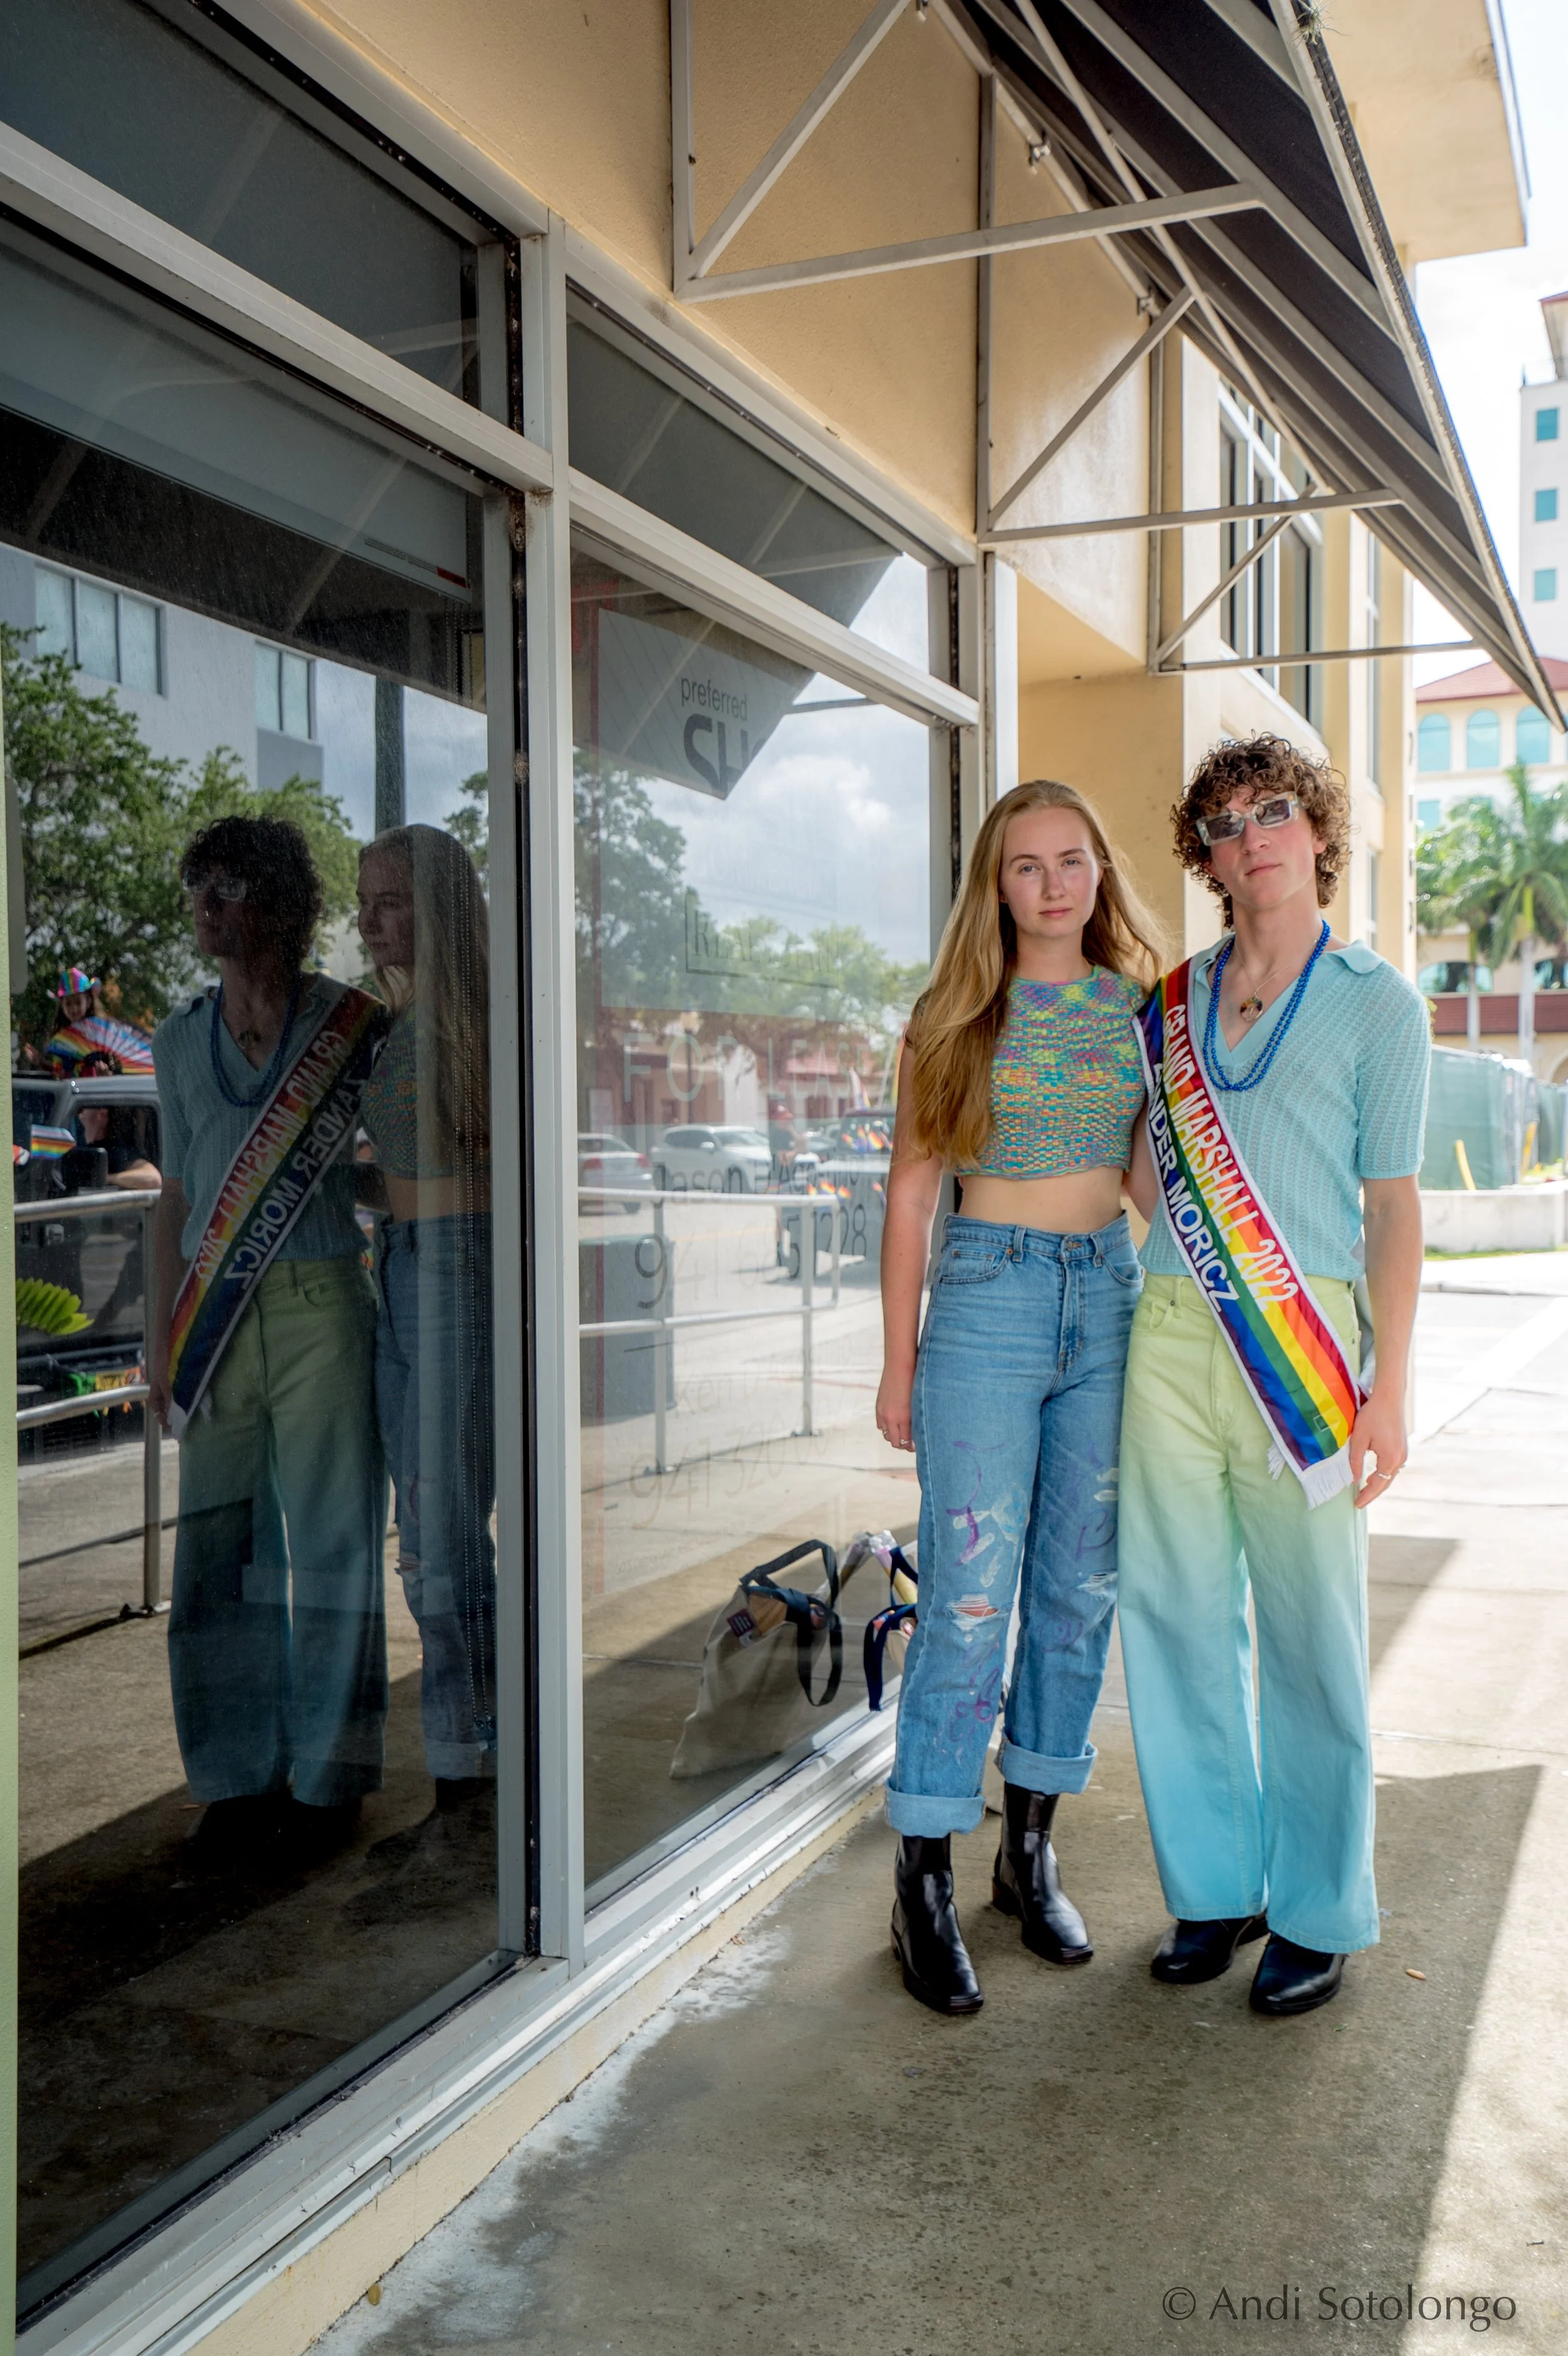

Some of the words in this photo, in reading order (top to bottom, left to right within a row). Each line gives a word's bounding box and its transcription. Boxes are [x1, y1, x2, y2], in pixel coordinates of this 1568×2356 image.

[681, 677, 748, 721] preferred
[623, 1032, 744, 1102] FOR
[768, 1038, 872, 1100] LEASE
[1163, 1004, 1196, 1094] GRAND
[651, 1163, 744, 1209] Jason
[1170, 1088, 1259, 1244] MARSHALL
[1167, 1176, 1239, 1312] MORICZ
[1231, 1239, 1298, 1312] 2022
